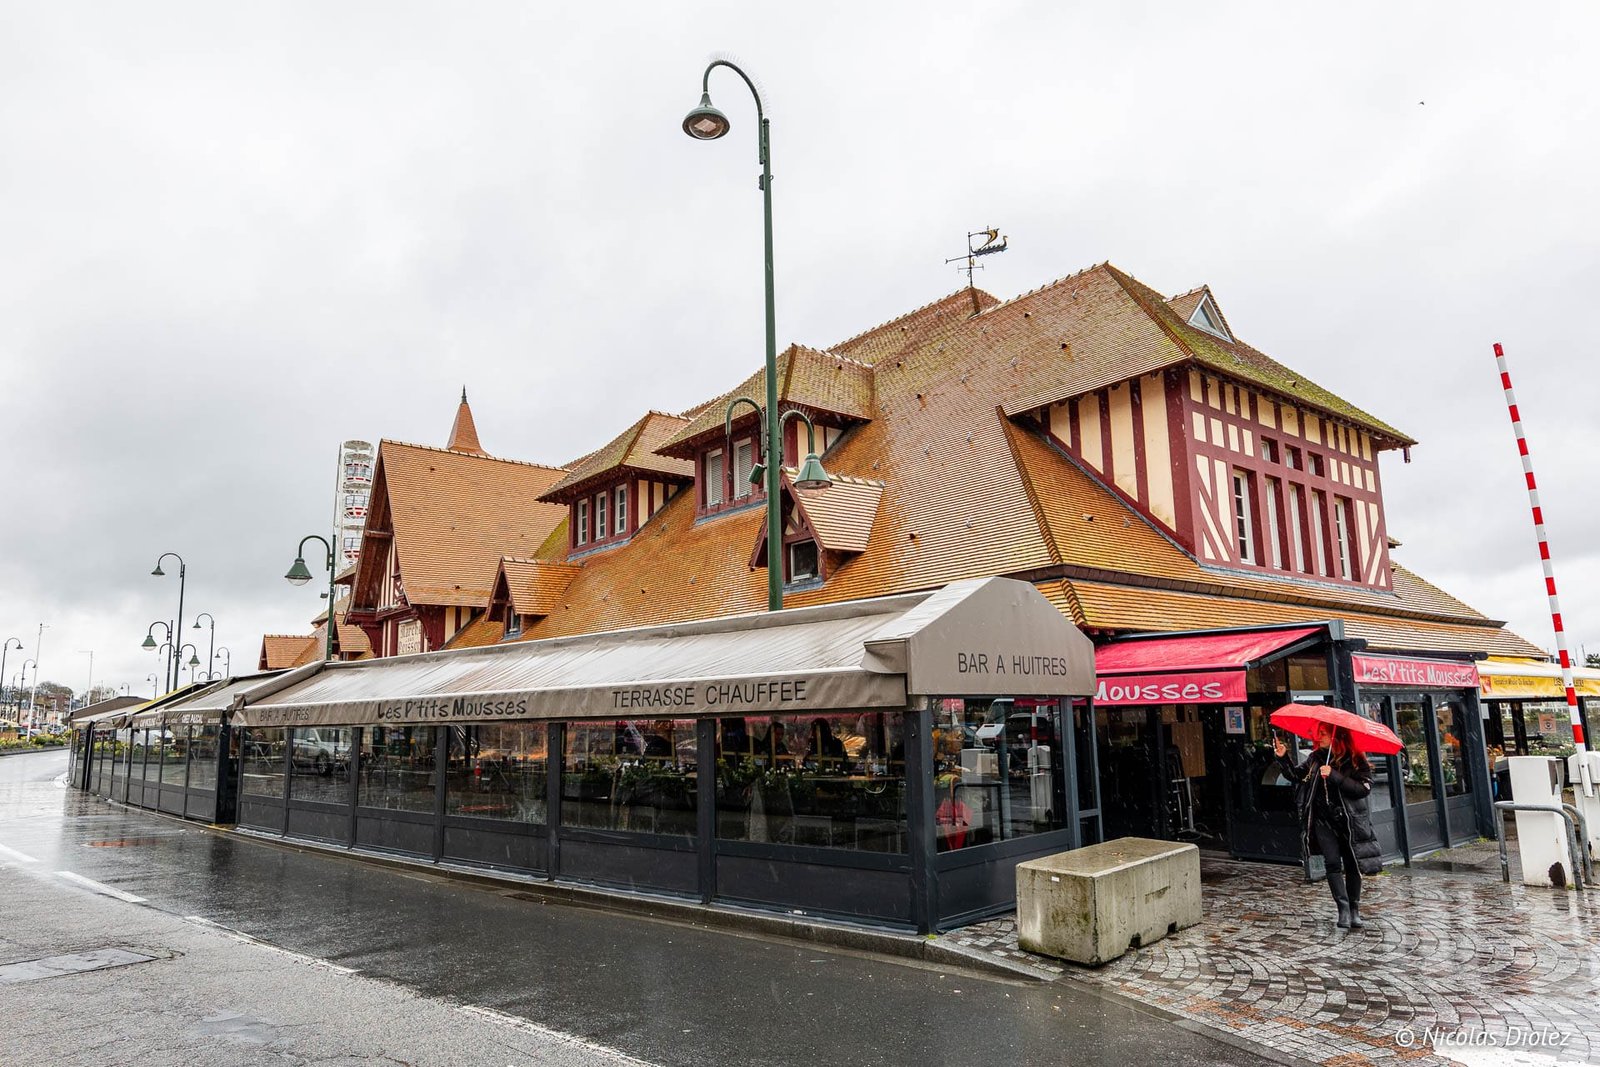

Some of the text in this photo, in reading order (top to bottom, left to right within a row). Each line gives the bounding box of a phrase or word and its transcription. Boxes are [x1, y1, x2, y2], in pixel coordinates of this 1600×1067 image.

[958, 652, 1067, 676] BAR A HUITRES
[1362, 659, 1388, 681] Les
[1427, 665, 1473, 686] Mousses
[612, 681, 806, 708] TERRASSE CHAUFFEE
[260, 708, 273, 721] BAR
[377, 702, 401, 719] Les
[452, 698, 527, 717] Mousses
